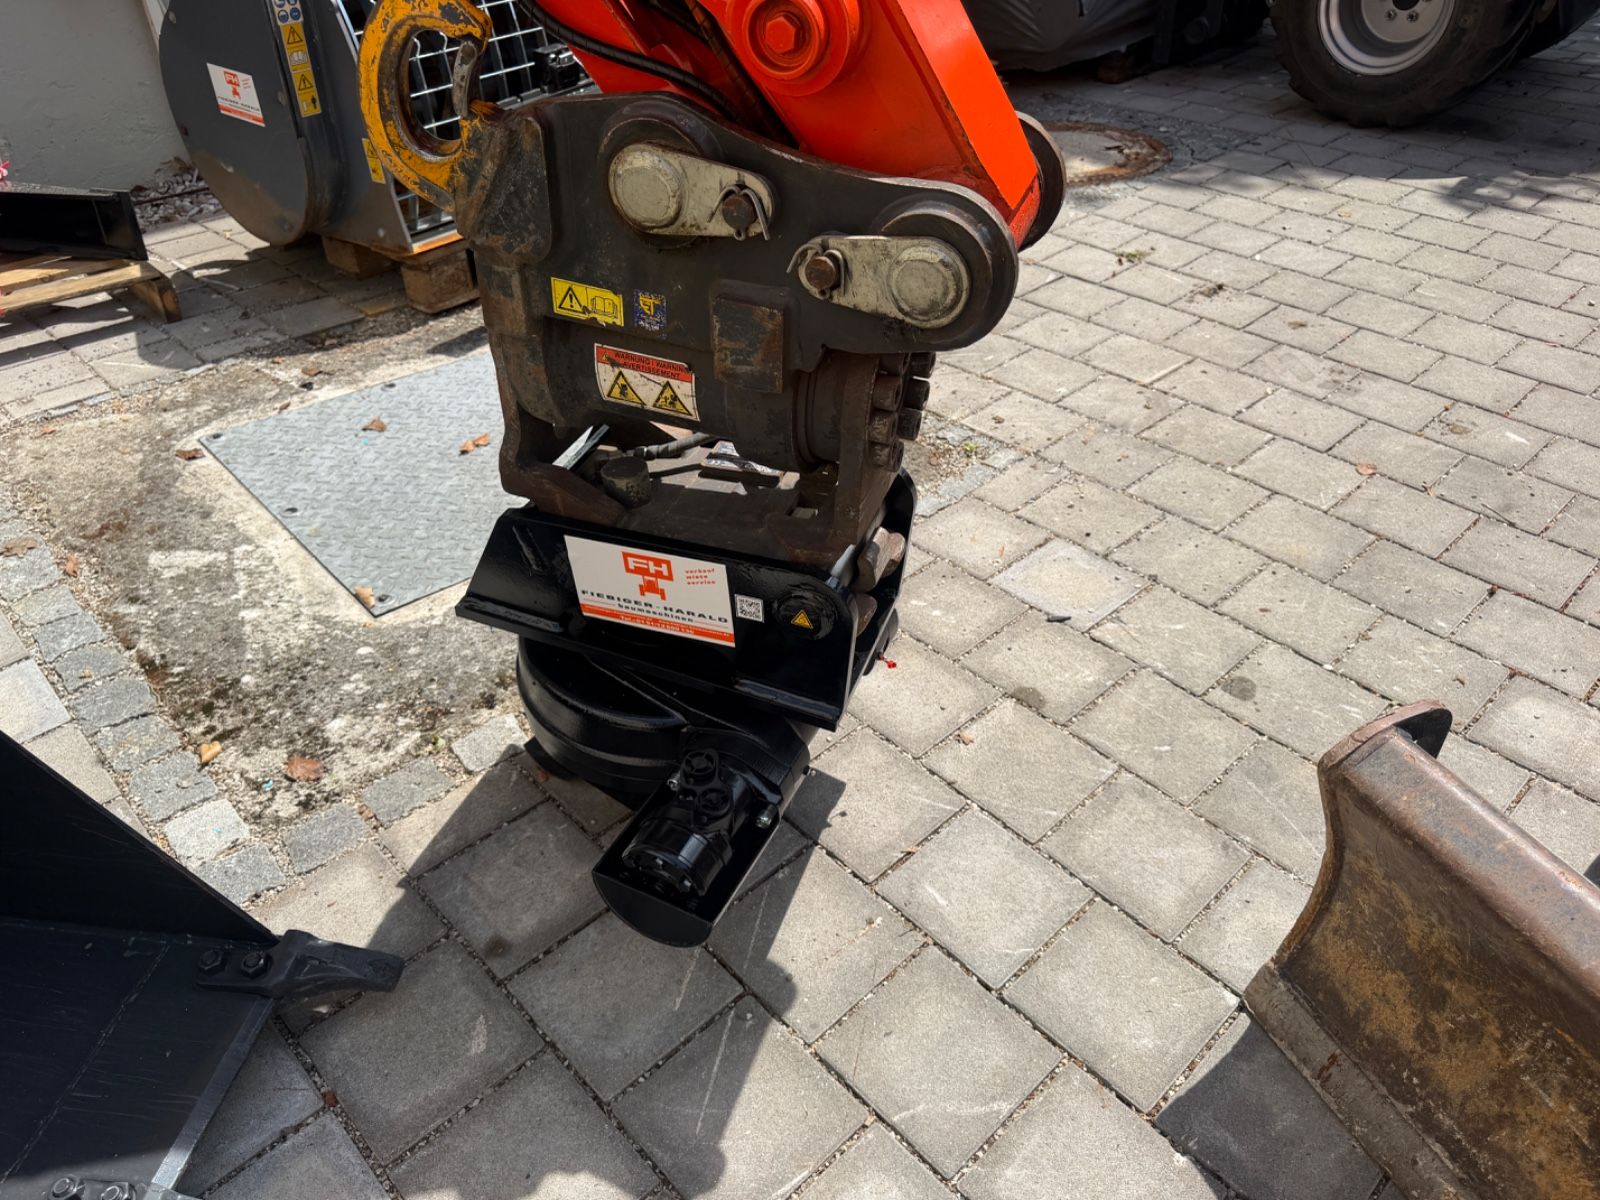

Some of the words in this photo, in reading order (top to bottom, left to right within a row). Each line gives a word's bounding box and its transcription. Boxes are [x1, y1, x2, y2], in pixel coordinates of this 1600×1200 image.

[627, 556, 670, 577] FH
[685, 567, 715, 575] verkauf
[581, 590, 653, 608] FIEBIGER
[663, 606, 728, 623] HARALD
[617, 602, 694, 623] baumaschinen
